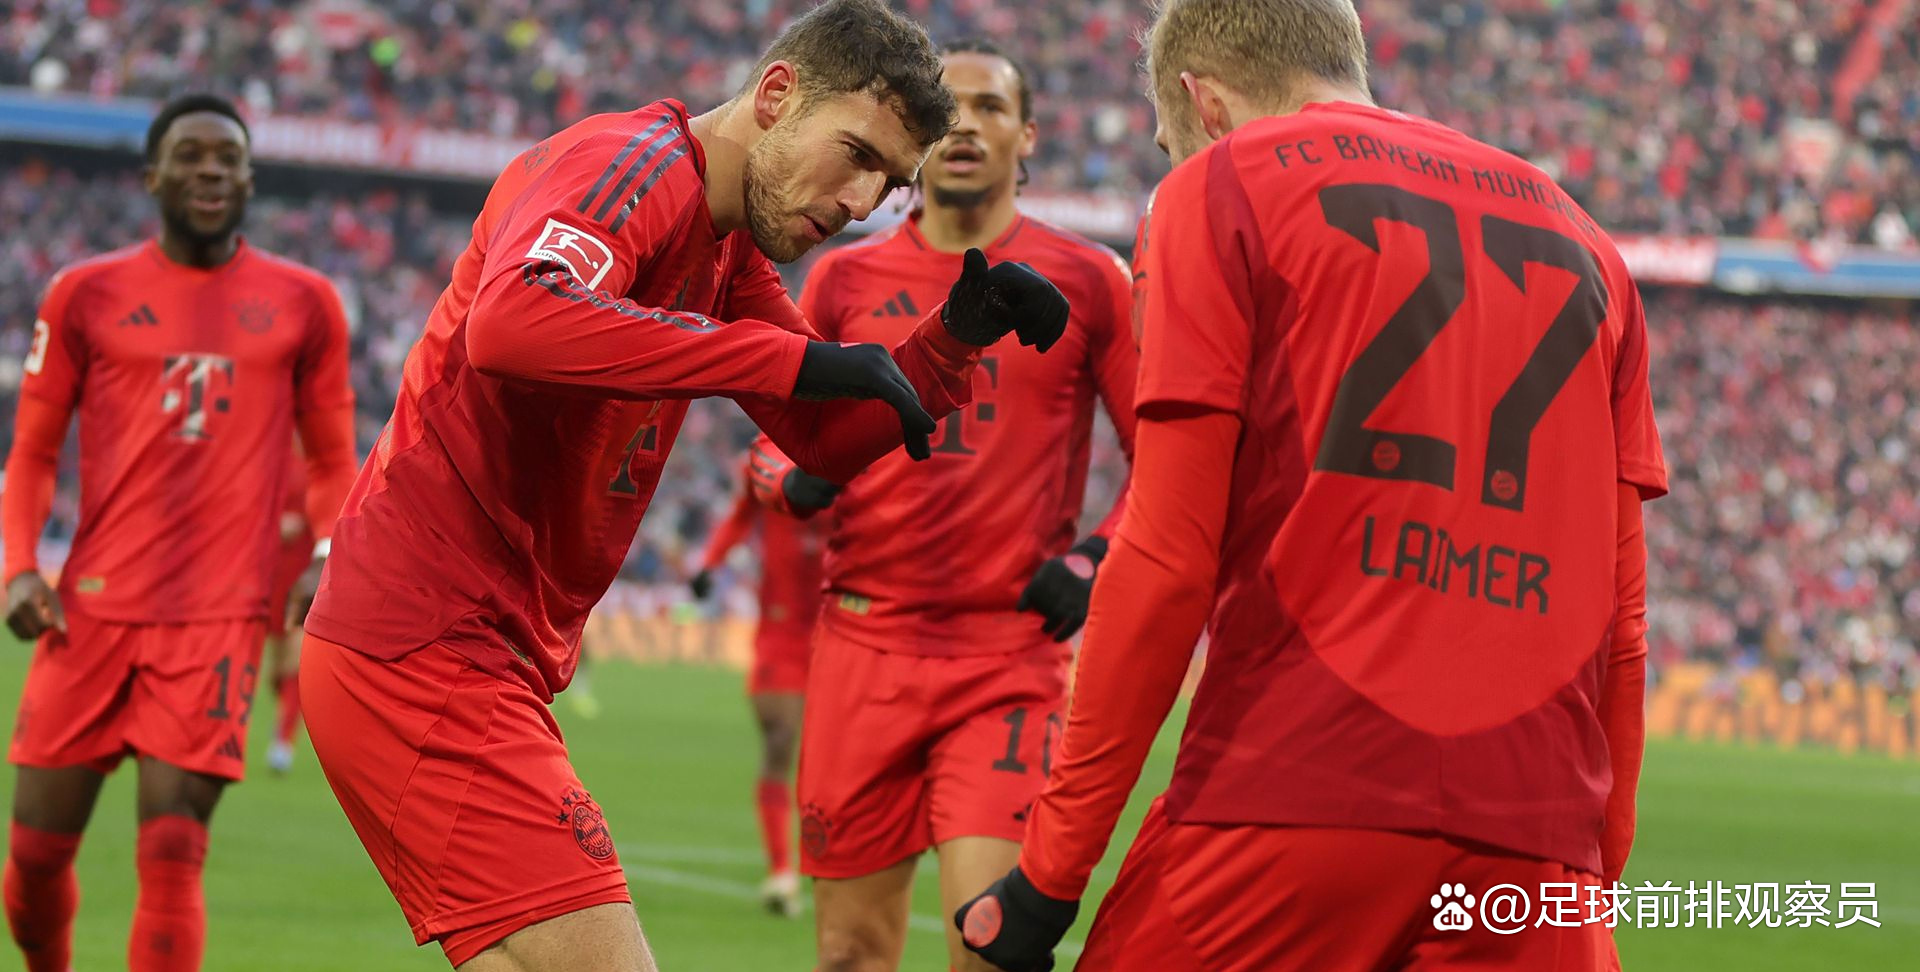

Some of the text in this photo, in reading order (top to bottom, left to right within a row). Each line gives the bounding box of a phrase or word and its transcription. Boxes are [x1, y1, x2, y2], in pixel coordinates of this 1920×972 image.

[1275, 140, 1321, 168] FC
[1333, 135, 1460, 184] BAYERN
[1314, 183, 1608, 512] 27
[1360, 516, 1550, 614] LAIMER
[207, 656, 257, 725] 19
